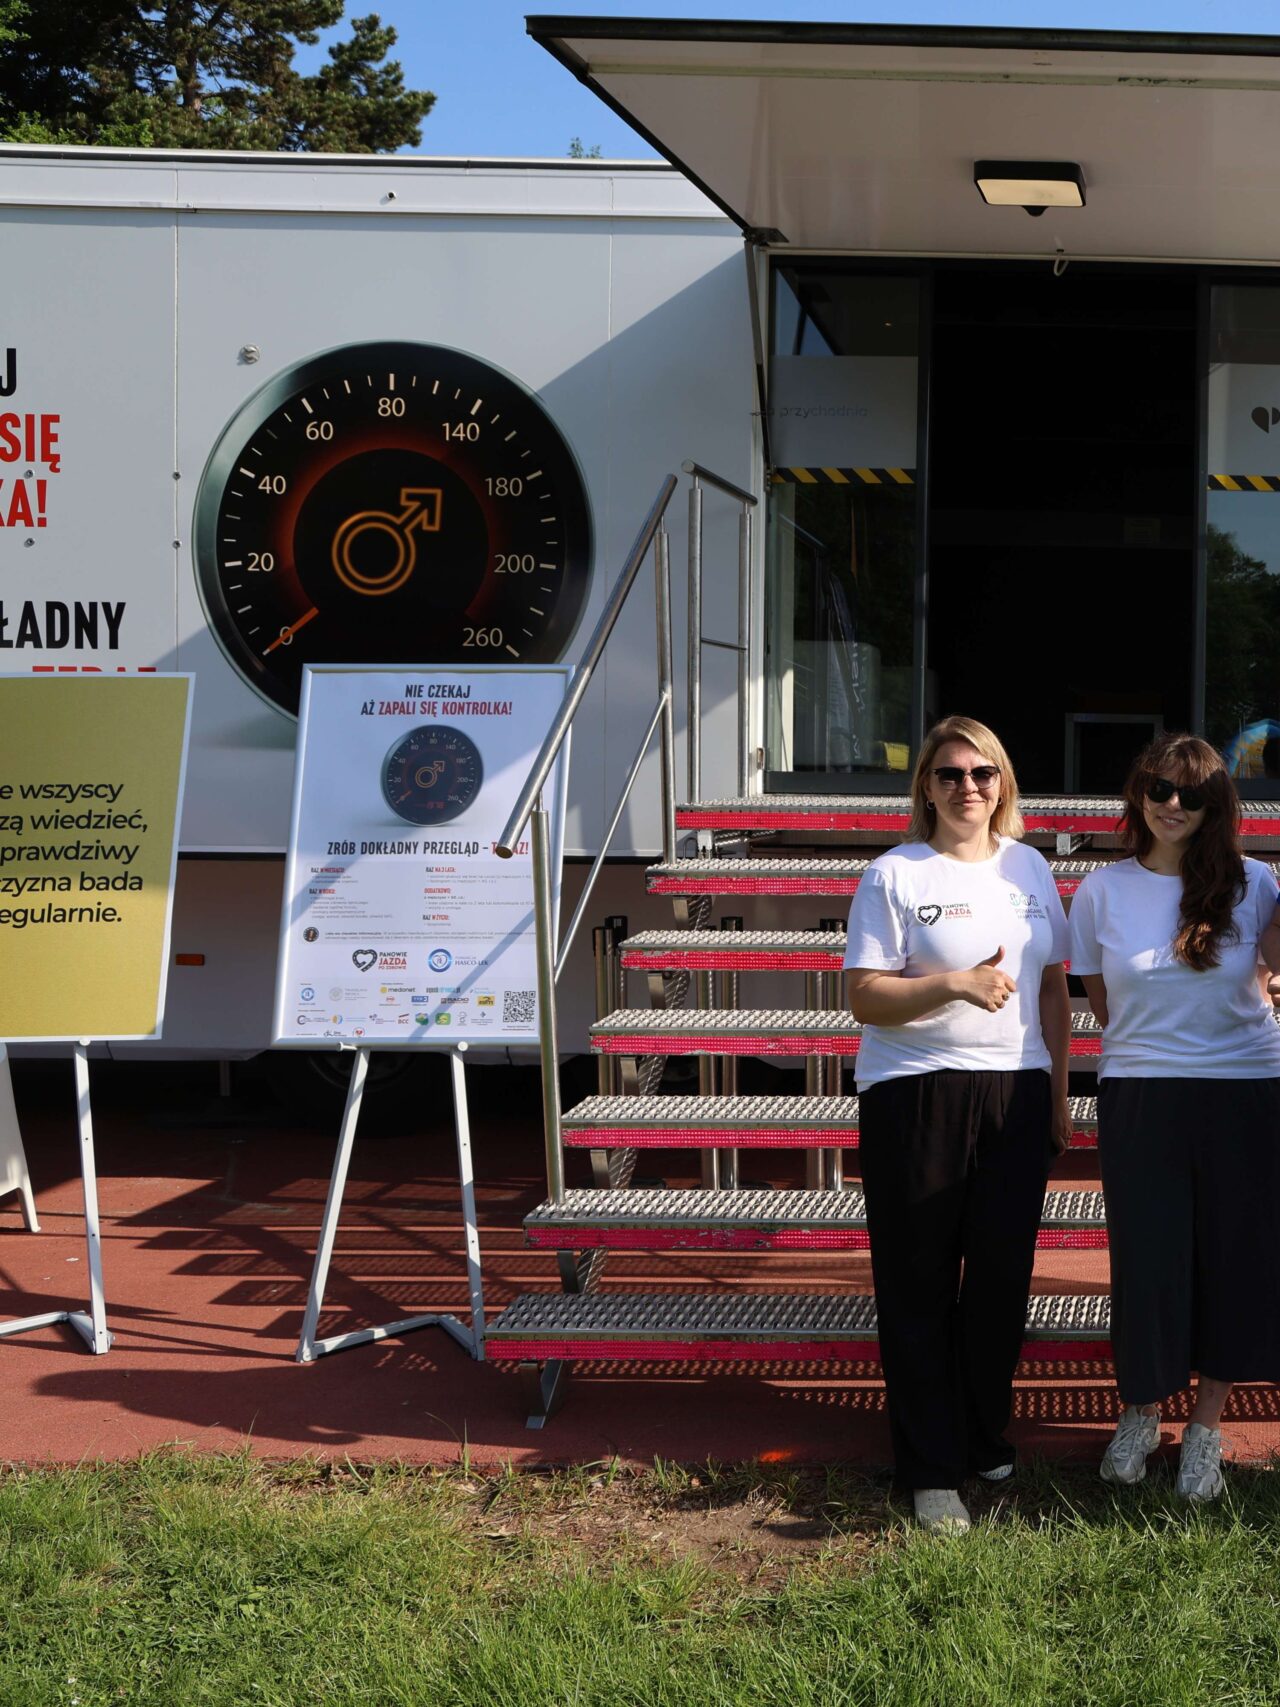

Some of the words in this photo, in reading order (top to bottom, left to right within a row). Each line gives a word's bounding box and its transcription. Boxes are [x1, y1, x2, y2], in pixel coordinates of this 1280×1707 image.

[377, 397, 406, 417] 80
[305, 421, 334, 440] 60
[442, 422, 480, 441] 140
[258, 475, 287, 495] 40
[485, 477, 523, 497] 180
[247, 552, 274, 572] 20
[494, 554, 535, 573] 200
[462, 627, 503, 647] 260
[405, 685, 423, 698] NIE
[427, 685, 471, 698] CZEKAJ
[361, 699, 375, 715] AŻ
[378, 702, 416, 715] ZAPALI
[419, 701, 437, 717] SIĘ
[442, 701, 513, 715] KONTROLKA!
[20, 784, 124, 803] wszyscy
[30, 809, 148, 832] wiedzieć,
[1, 840, 139, 866] prawdziwy
[327, 840, 356, 855] ZRÓB
[361, 841, 418, 855] DOKŁADNY
[423, 841, 479, 857] PRZEGLĄD
[79, 871, 143, 891] bada
